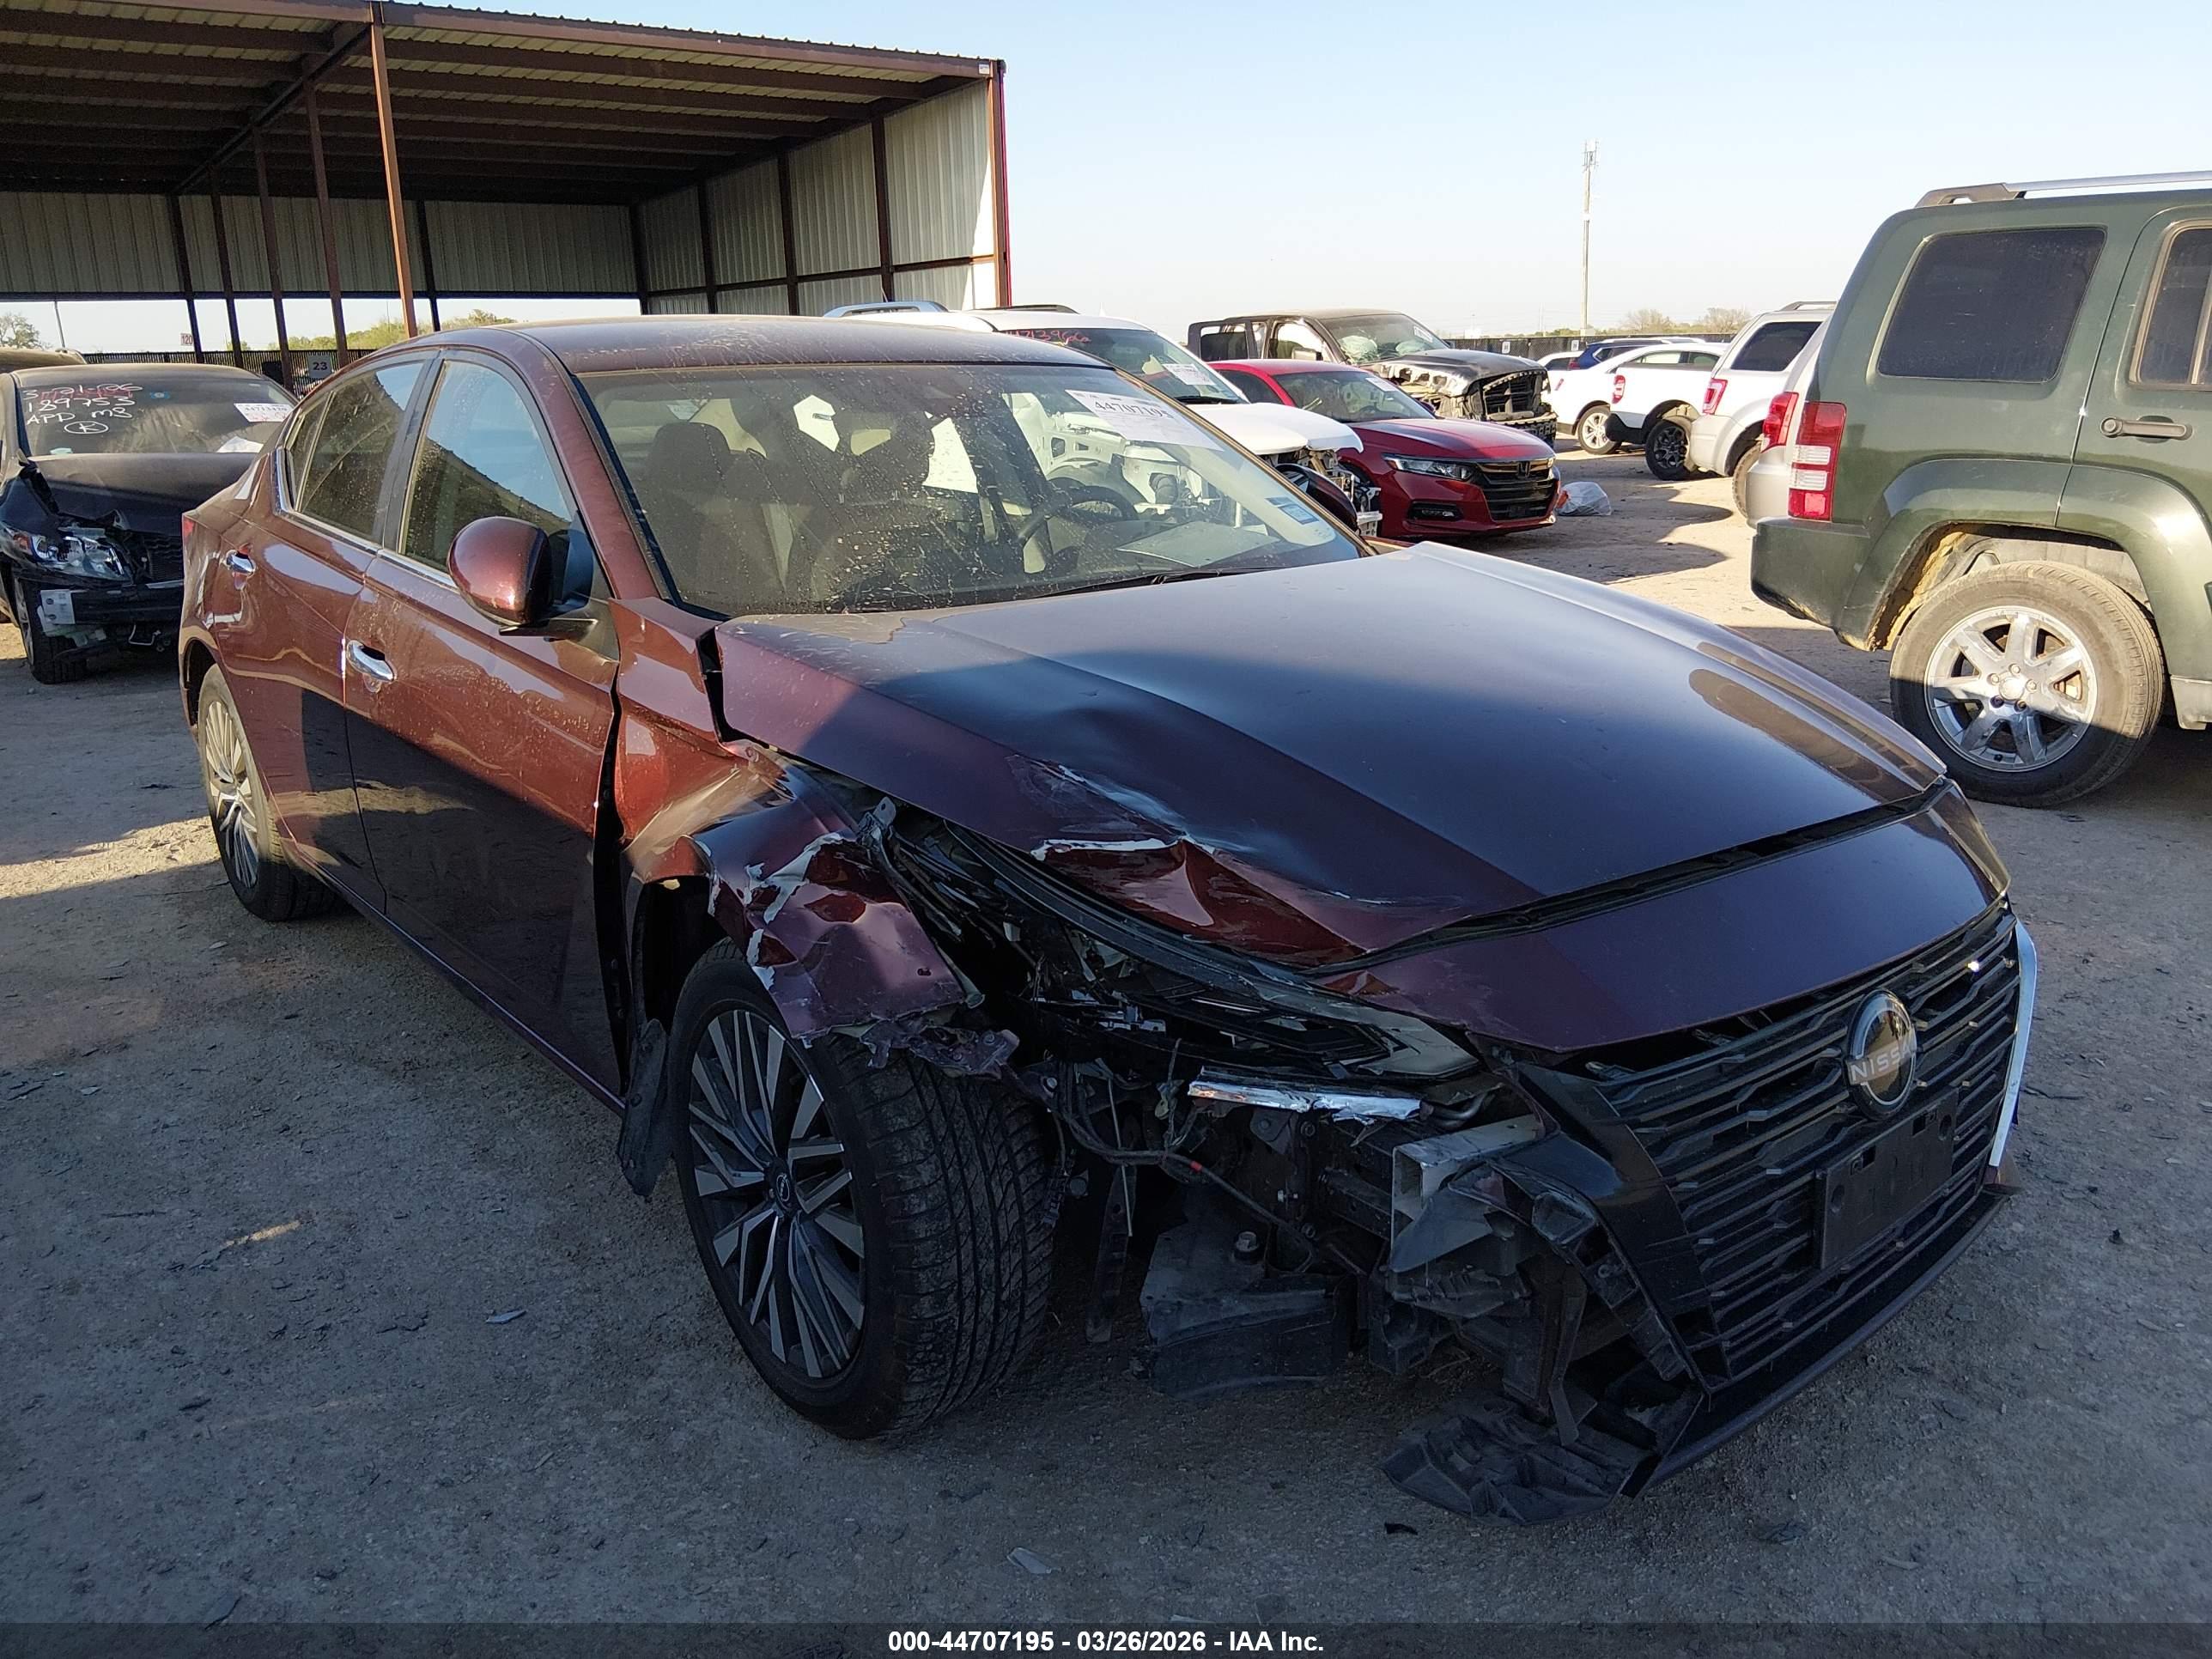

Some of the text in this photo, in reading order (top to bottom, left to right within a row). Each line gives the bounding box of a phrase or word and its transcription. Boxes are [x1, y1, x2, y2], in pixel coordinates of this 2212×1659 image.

[180, 335, 193, 345] 120
[313, 362, 328, 371] 23
[28, 397, 136, 412] 189753
[1094, 401, 1175, 419] 44707195
[27, 412, 76, 425] APD
[1850, 1042, 1914, 1082] NISSA
